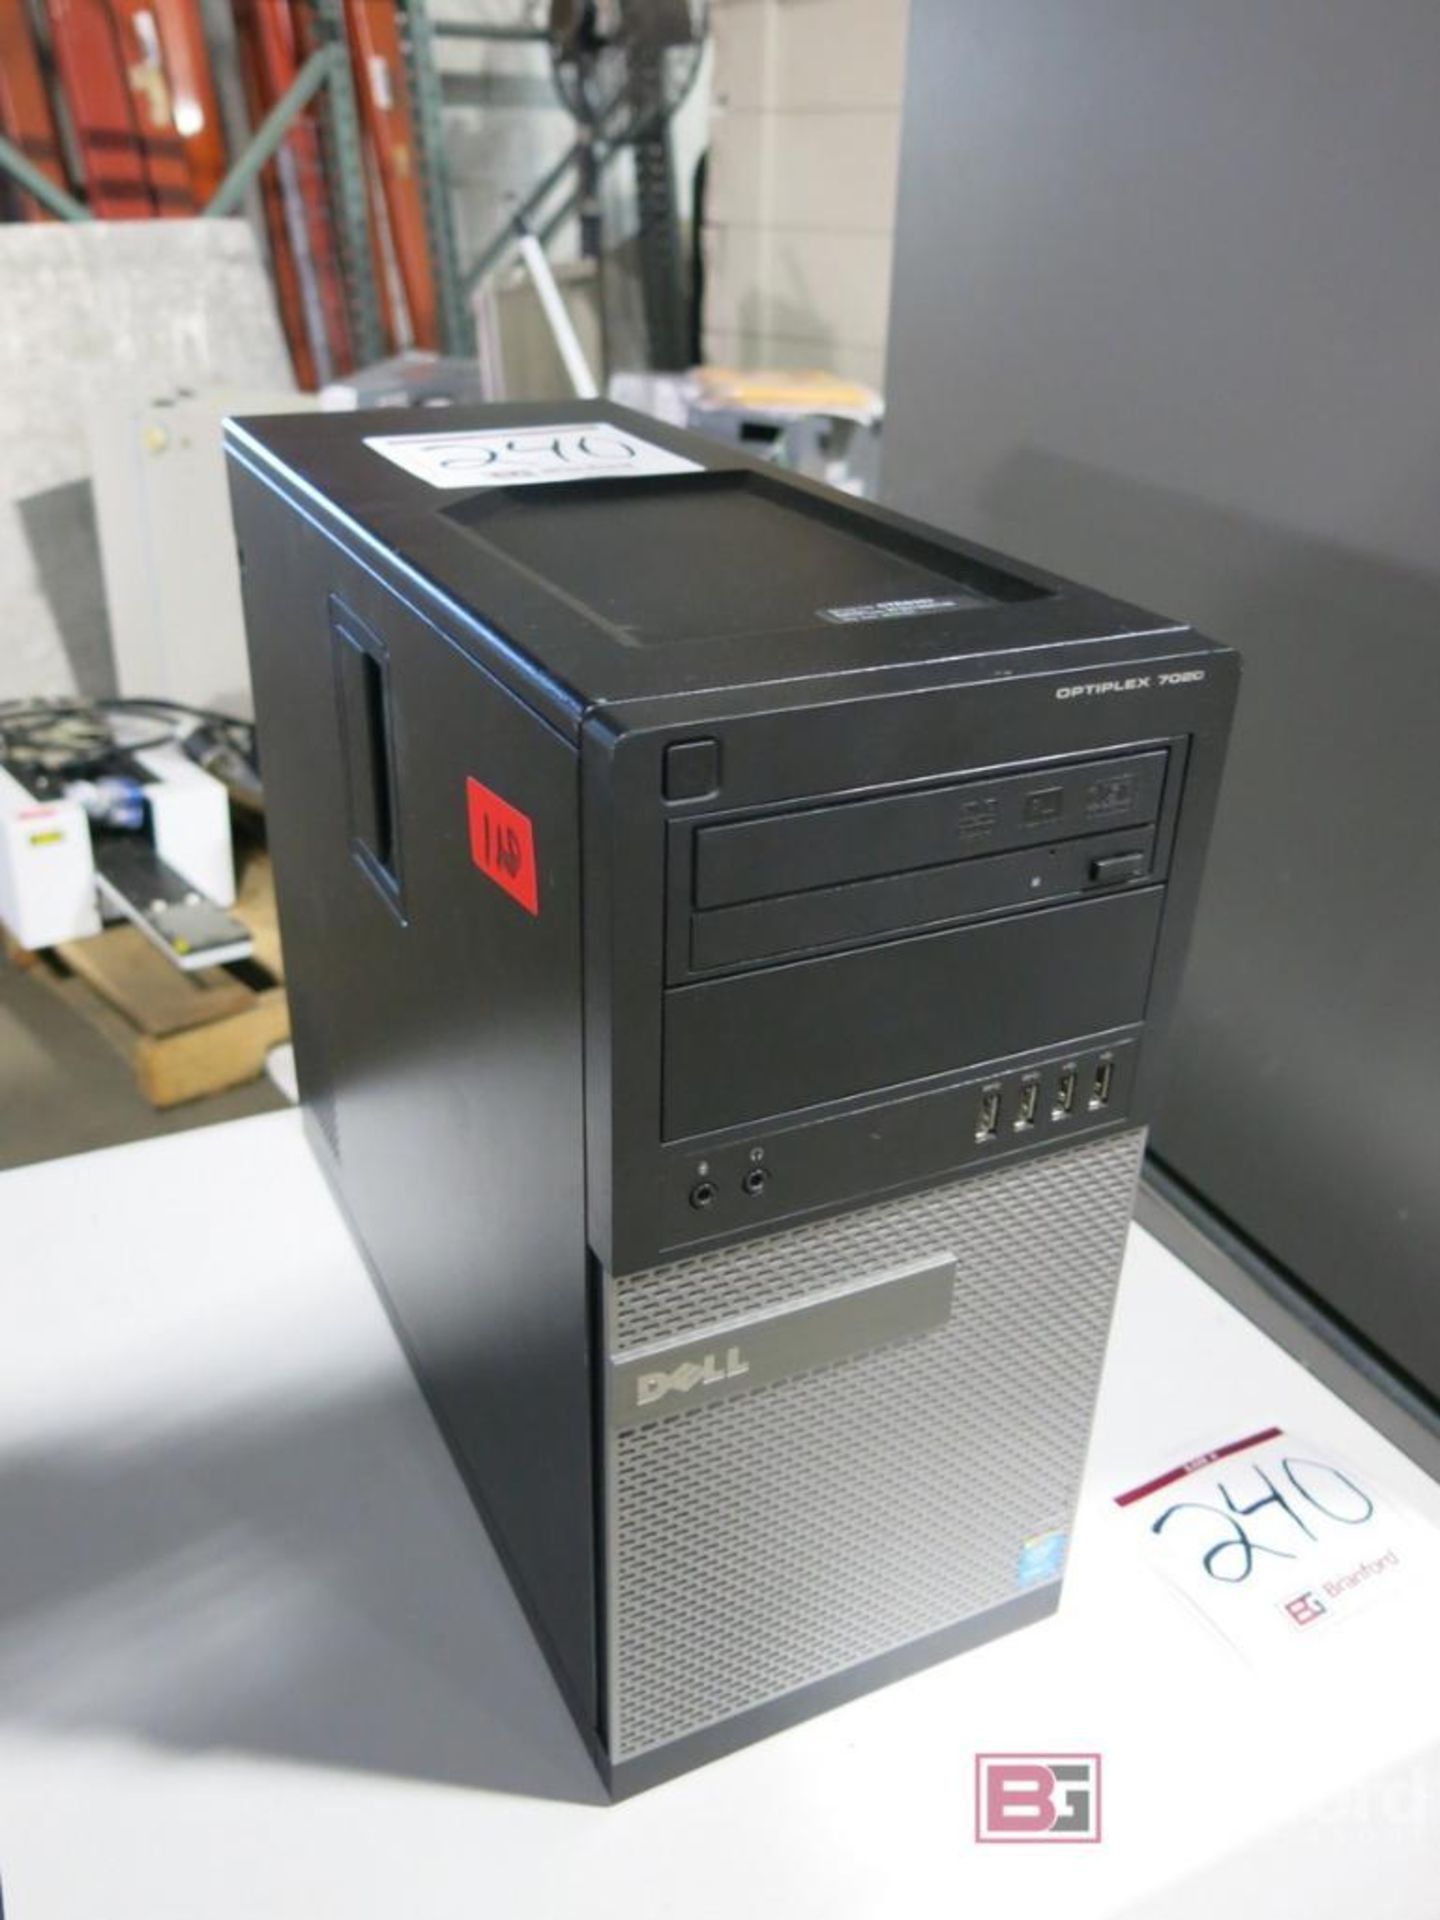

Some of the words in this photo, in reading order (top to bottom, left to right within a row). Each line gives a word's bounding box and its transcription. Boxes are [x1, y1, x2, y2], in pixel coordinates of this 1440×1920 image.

[1055, 676, 1151, 700] OPTIPLEX
[636, 1346, 750, 1407] DELL
[1151, 1457, 1374, 1583] 240
[1322, 1547, 1400, 1599] Branford
